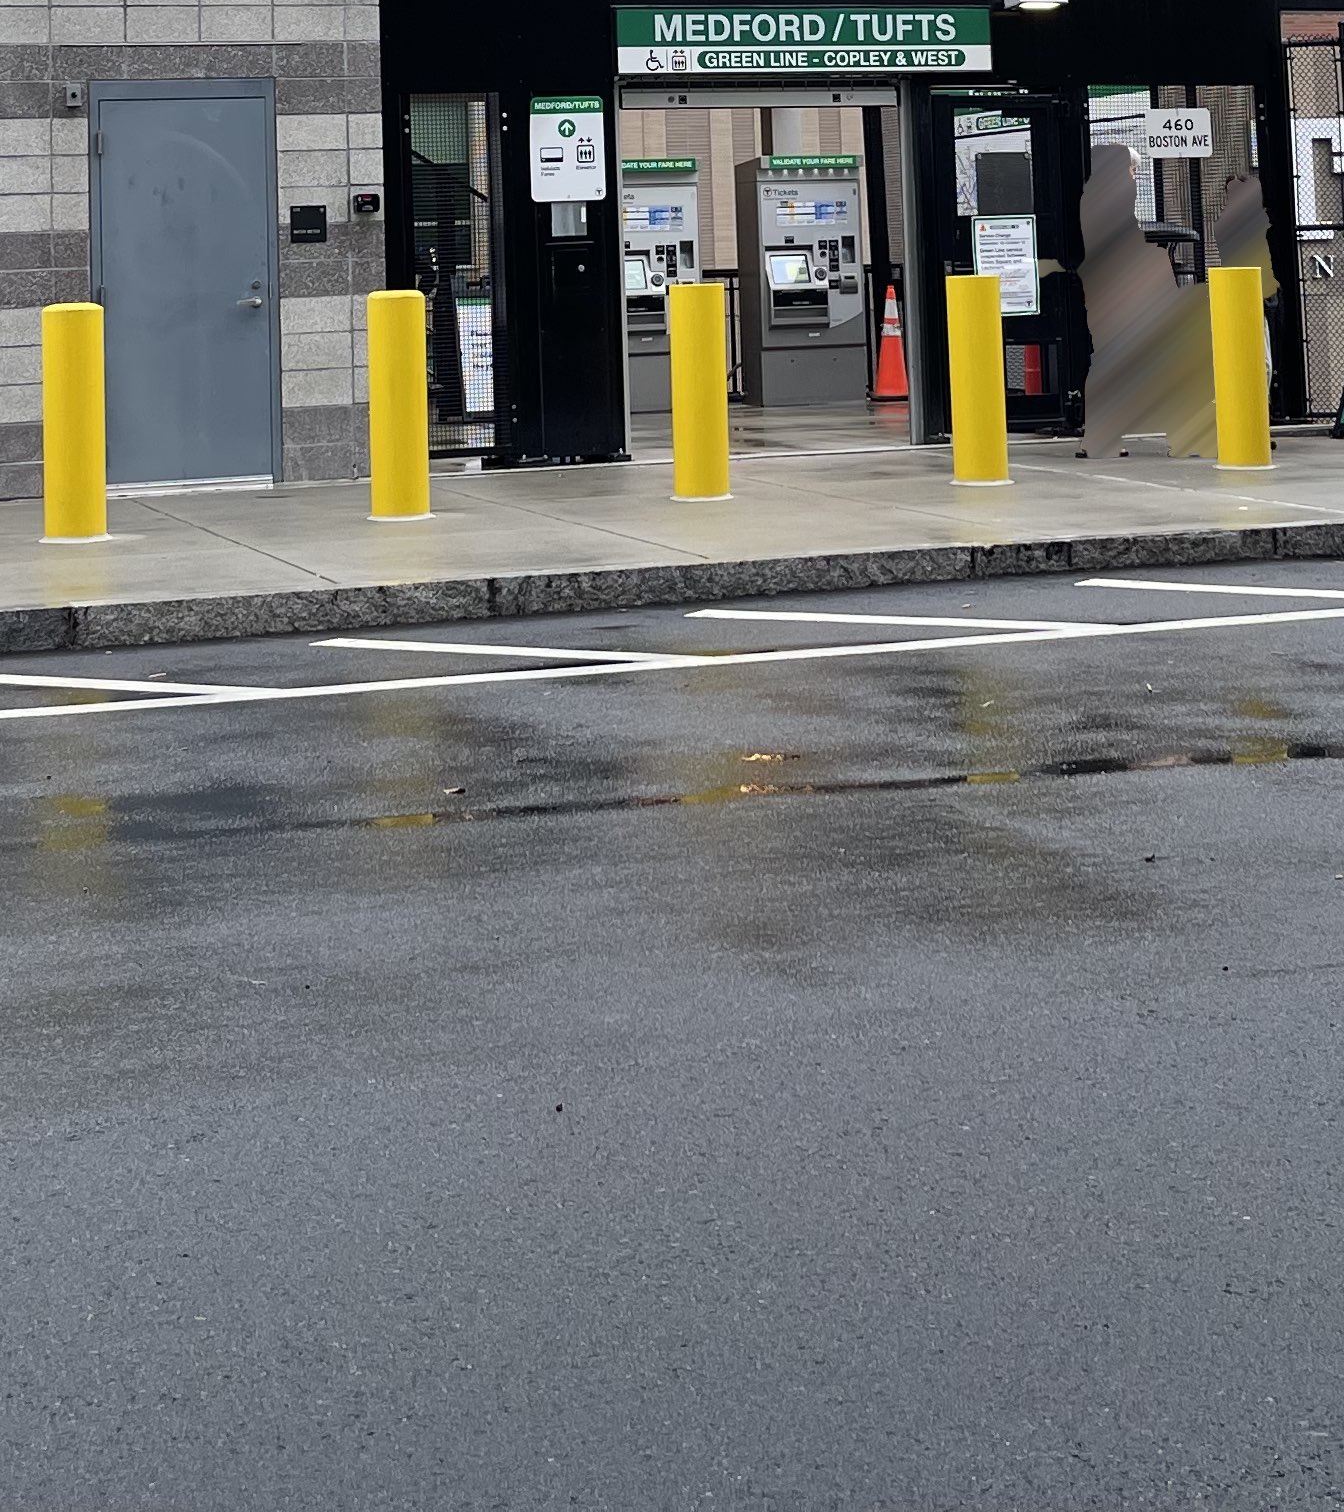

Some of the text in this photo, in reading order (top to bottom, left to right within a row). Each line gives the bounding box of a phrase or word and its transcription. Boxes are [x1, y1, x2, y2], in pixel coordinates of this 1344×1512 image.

[654, 13, 826, 42] MEDFORD
[850, 13, 956, 41] TUFTS
[704, 53, 766, 68] GREEN
[770, 53, 807, 67] LINE
[826, 52, 893, 67] COPLEY
[896, 52, 907, 66] &
[911, 51, 959, 66] WEST
[1162, 119, 1194, 131] 460
[1148, 135, 1209, 148] BOSTON AVE
[773, 188, 798, 196] Tickets
